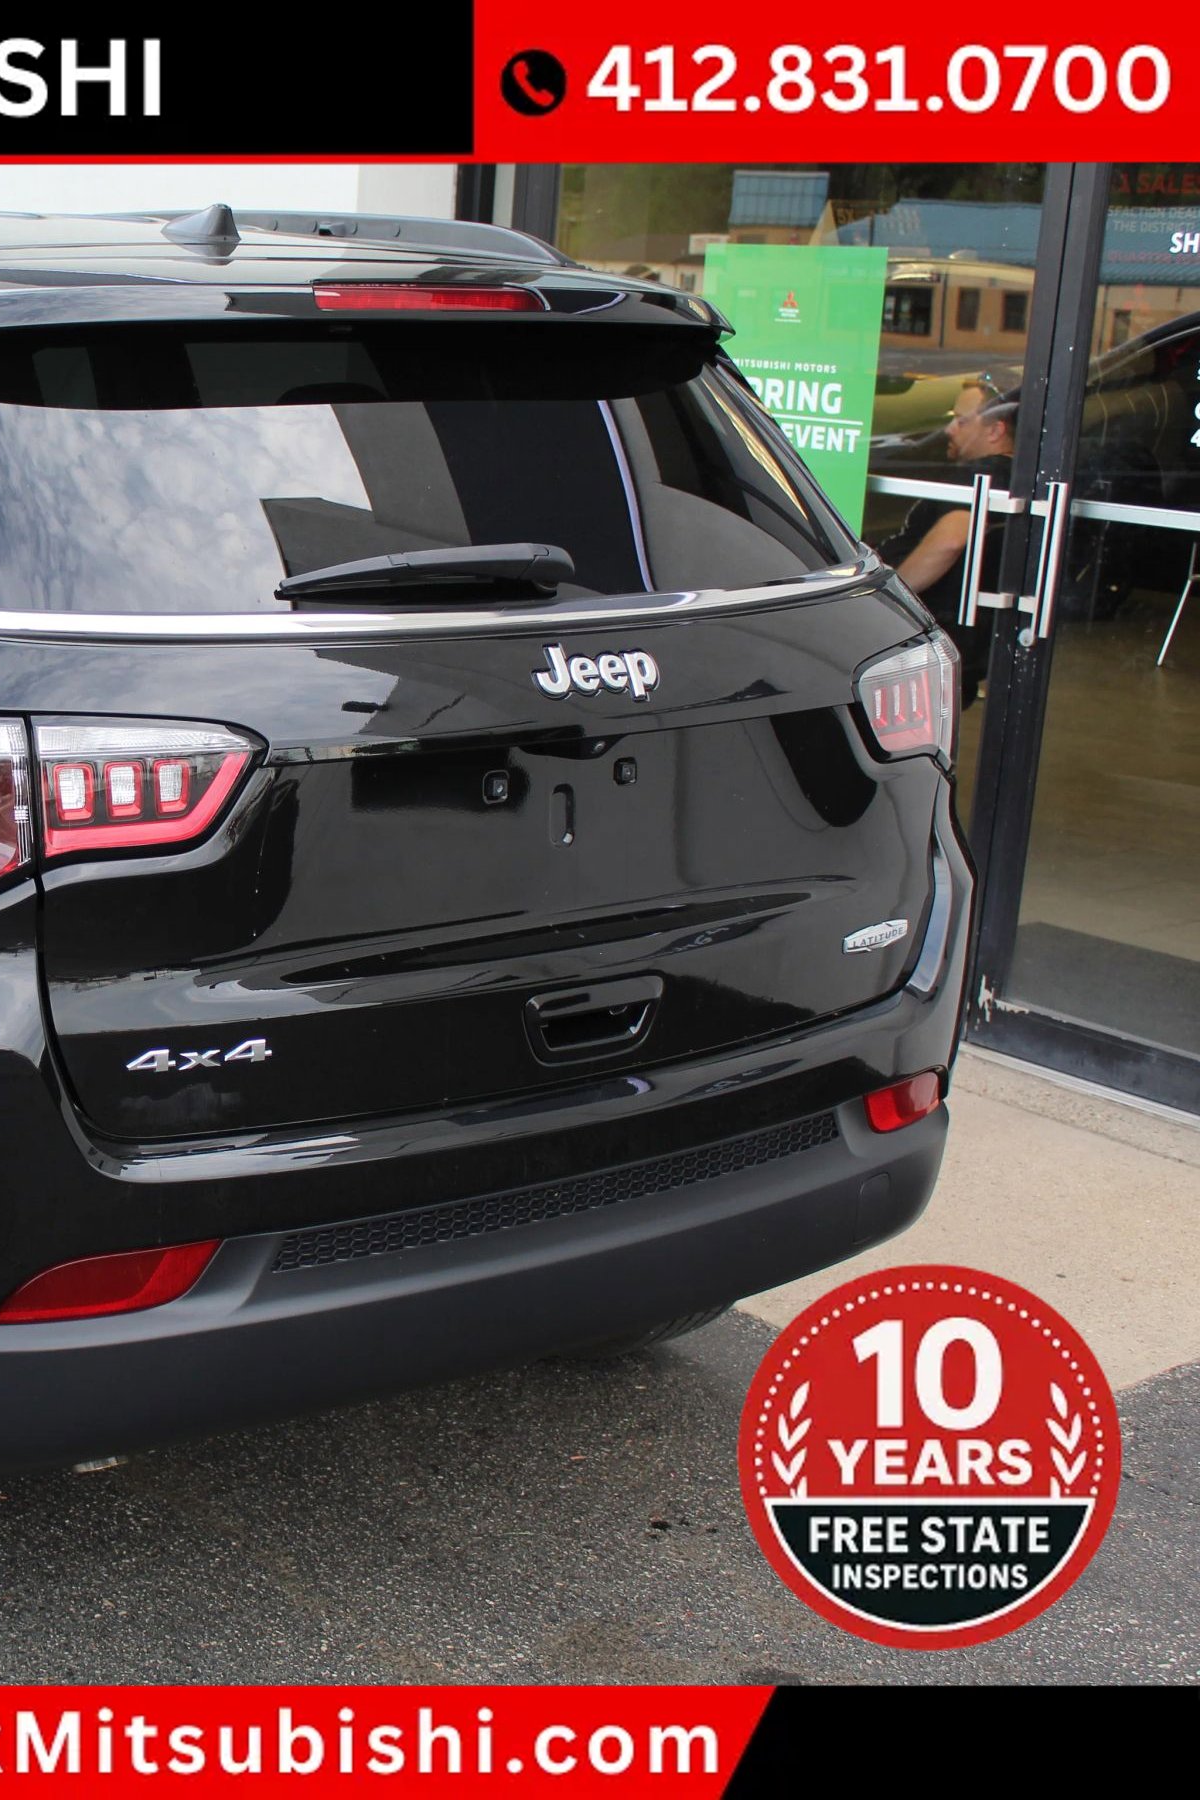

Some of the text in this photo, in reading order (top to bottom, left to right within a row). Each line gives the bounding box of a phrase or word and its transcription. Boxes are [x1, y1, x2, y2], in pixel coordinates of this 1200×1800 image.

[1136, 171, 1200, 194] SALE
[794, 362, 837, 374] MOTORS
[531, 643, 660, 702] Jeep
[853, 926, 904, 948] LATITUDE
